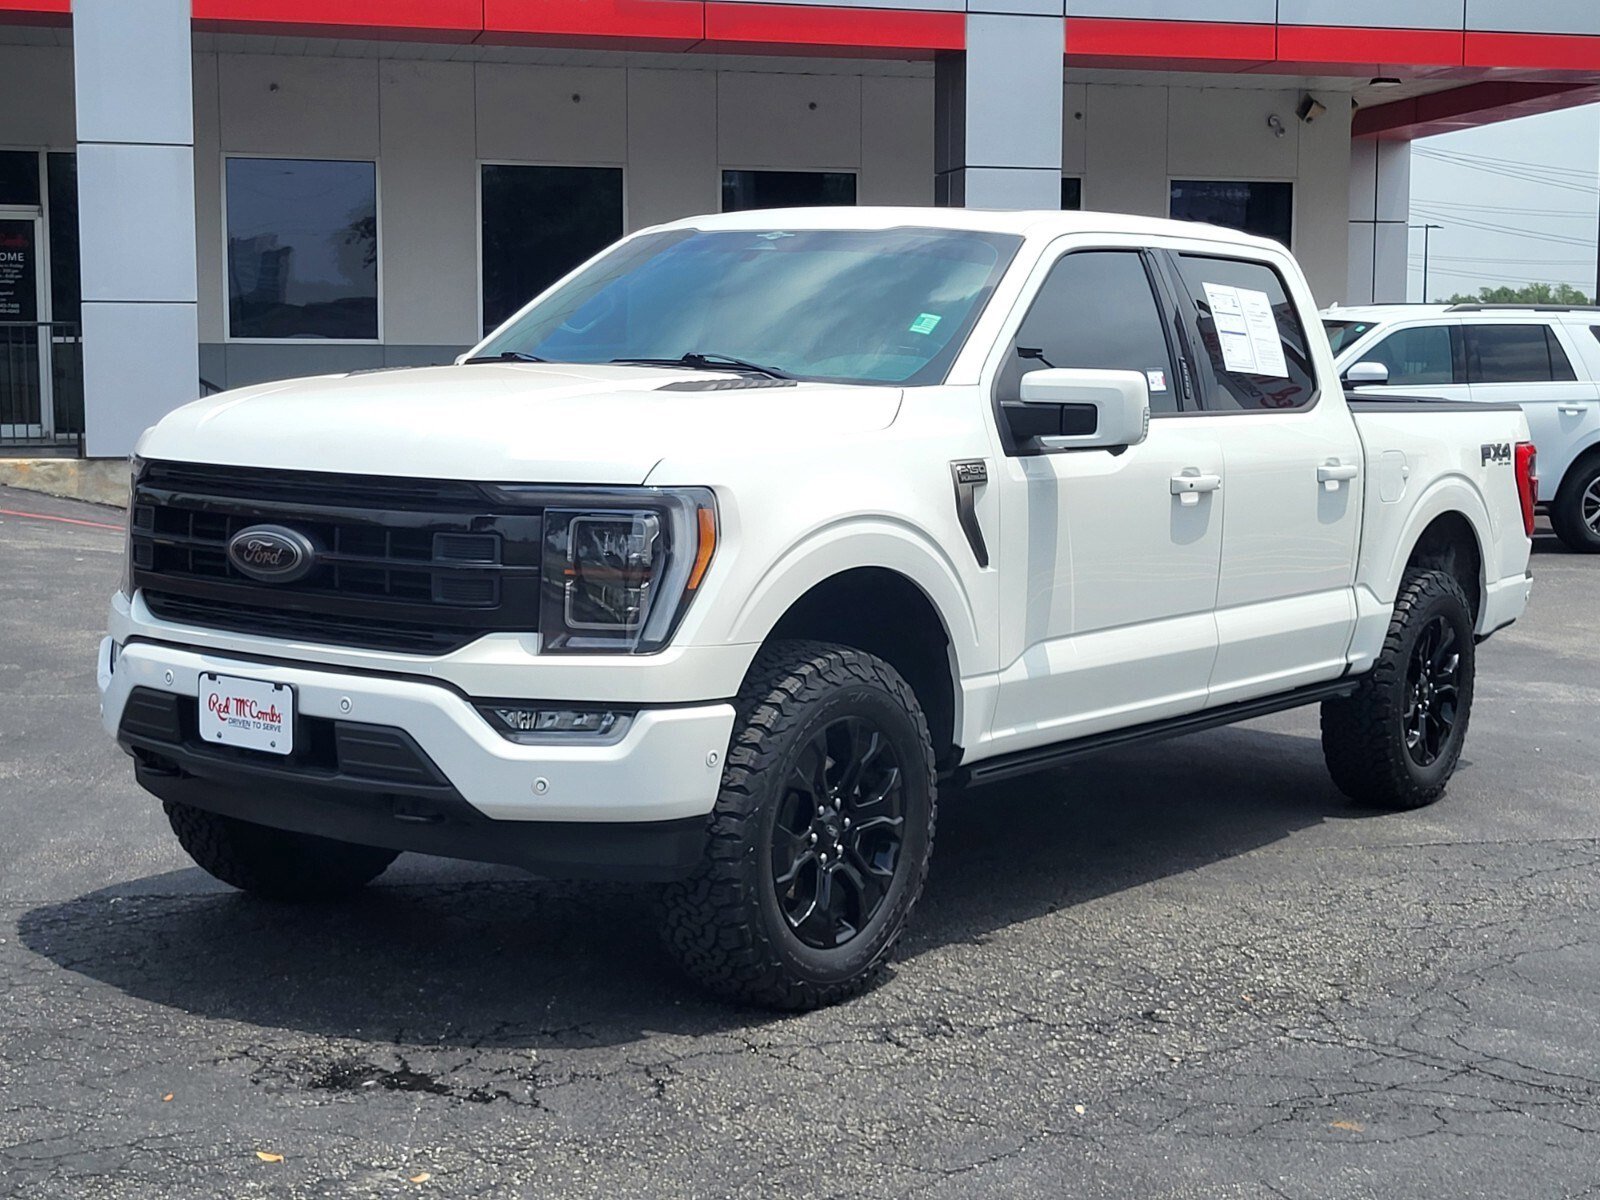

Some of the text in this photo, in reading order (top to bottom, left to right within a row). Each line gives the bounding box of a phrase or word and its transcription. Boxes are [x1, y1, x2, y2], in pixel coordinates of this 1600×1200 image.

[1480, 443, 1512, 467] FX4
[243, 539, 282, 565] Ford
[208, 693, 283, 723] Red McCombs
[228, 717, 282, 733] DRIVEN TO SERVE
